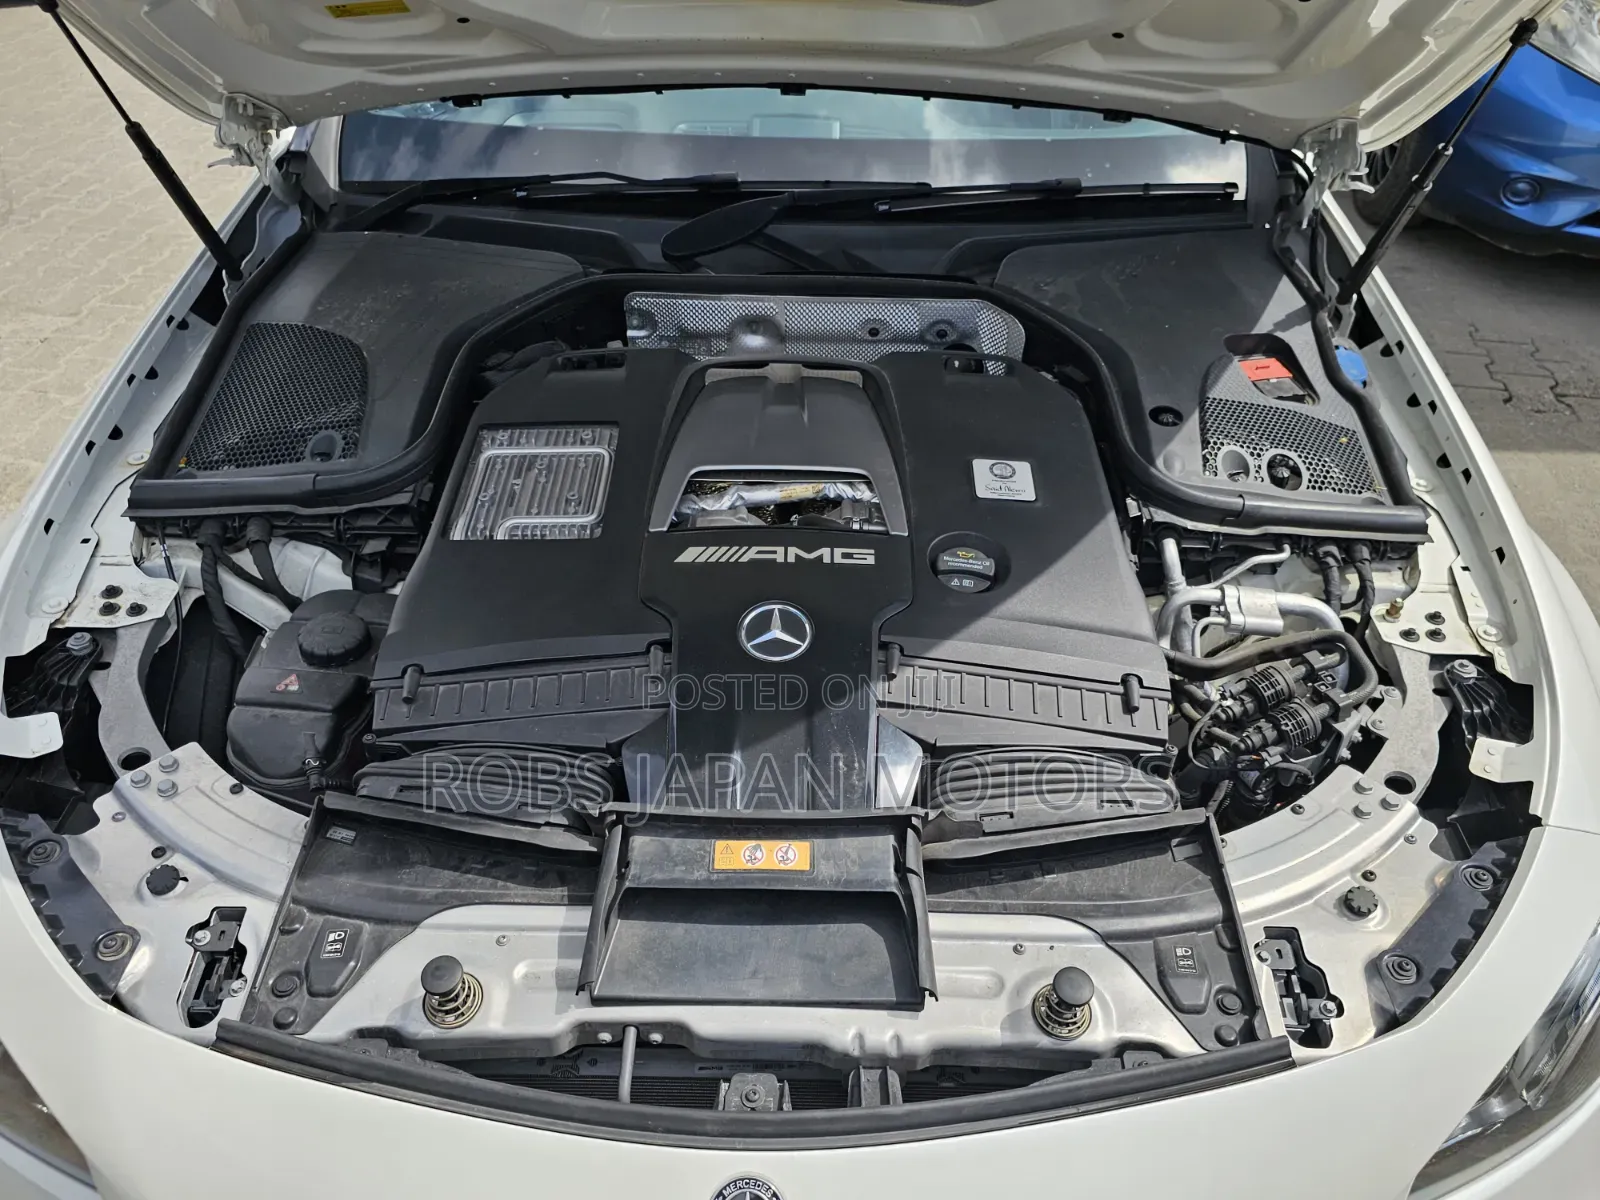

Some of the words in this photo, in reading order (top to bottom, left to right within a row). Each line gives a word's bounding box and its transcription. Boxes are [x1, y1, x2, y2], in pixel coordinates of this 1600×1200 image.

[738, 546, 876, 565] AMG
[943, 555, 982, 565] Mercedes-Benz
[947, 561, 983, 570] recommended
[722, 1179, 774, 1198] MERCEDES
